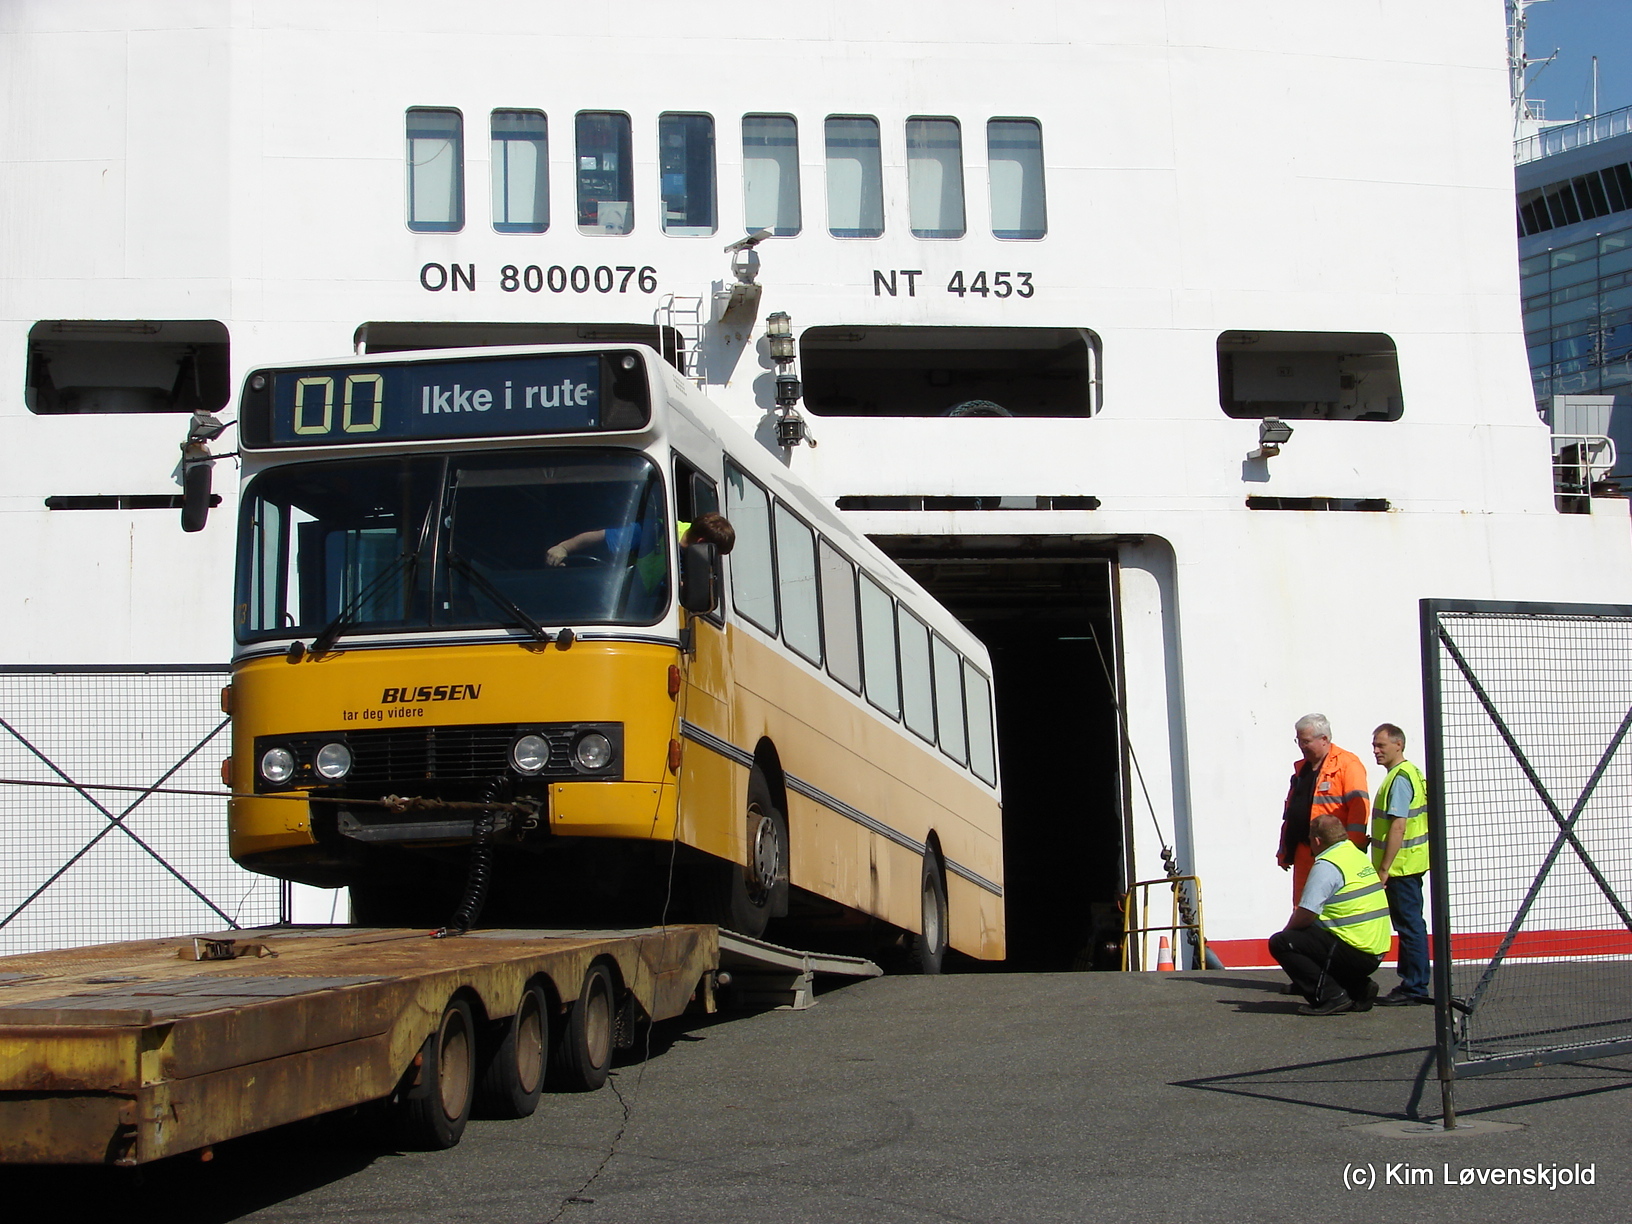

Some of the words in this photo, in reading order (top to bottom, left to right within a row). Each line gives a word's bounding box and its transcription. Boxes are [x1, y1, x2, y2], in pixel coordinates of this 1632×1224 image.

[420, 262, 476, 292] ON
[500, 264, 658, 294] 8000076
[873, 269, 923, 297] NT
[947, 270, 1035, 299] 4453
[422, 384, 493, 415] Ikke
[504, 380, 513, 410] i
[381, 683, 482, 704] BUSSEN
[343, 709, 359, 721] tar
[362, 708, 383, 721] deg
[388, 706, 424, 719] videre
